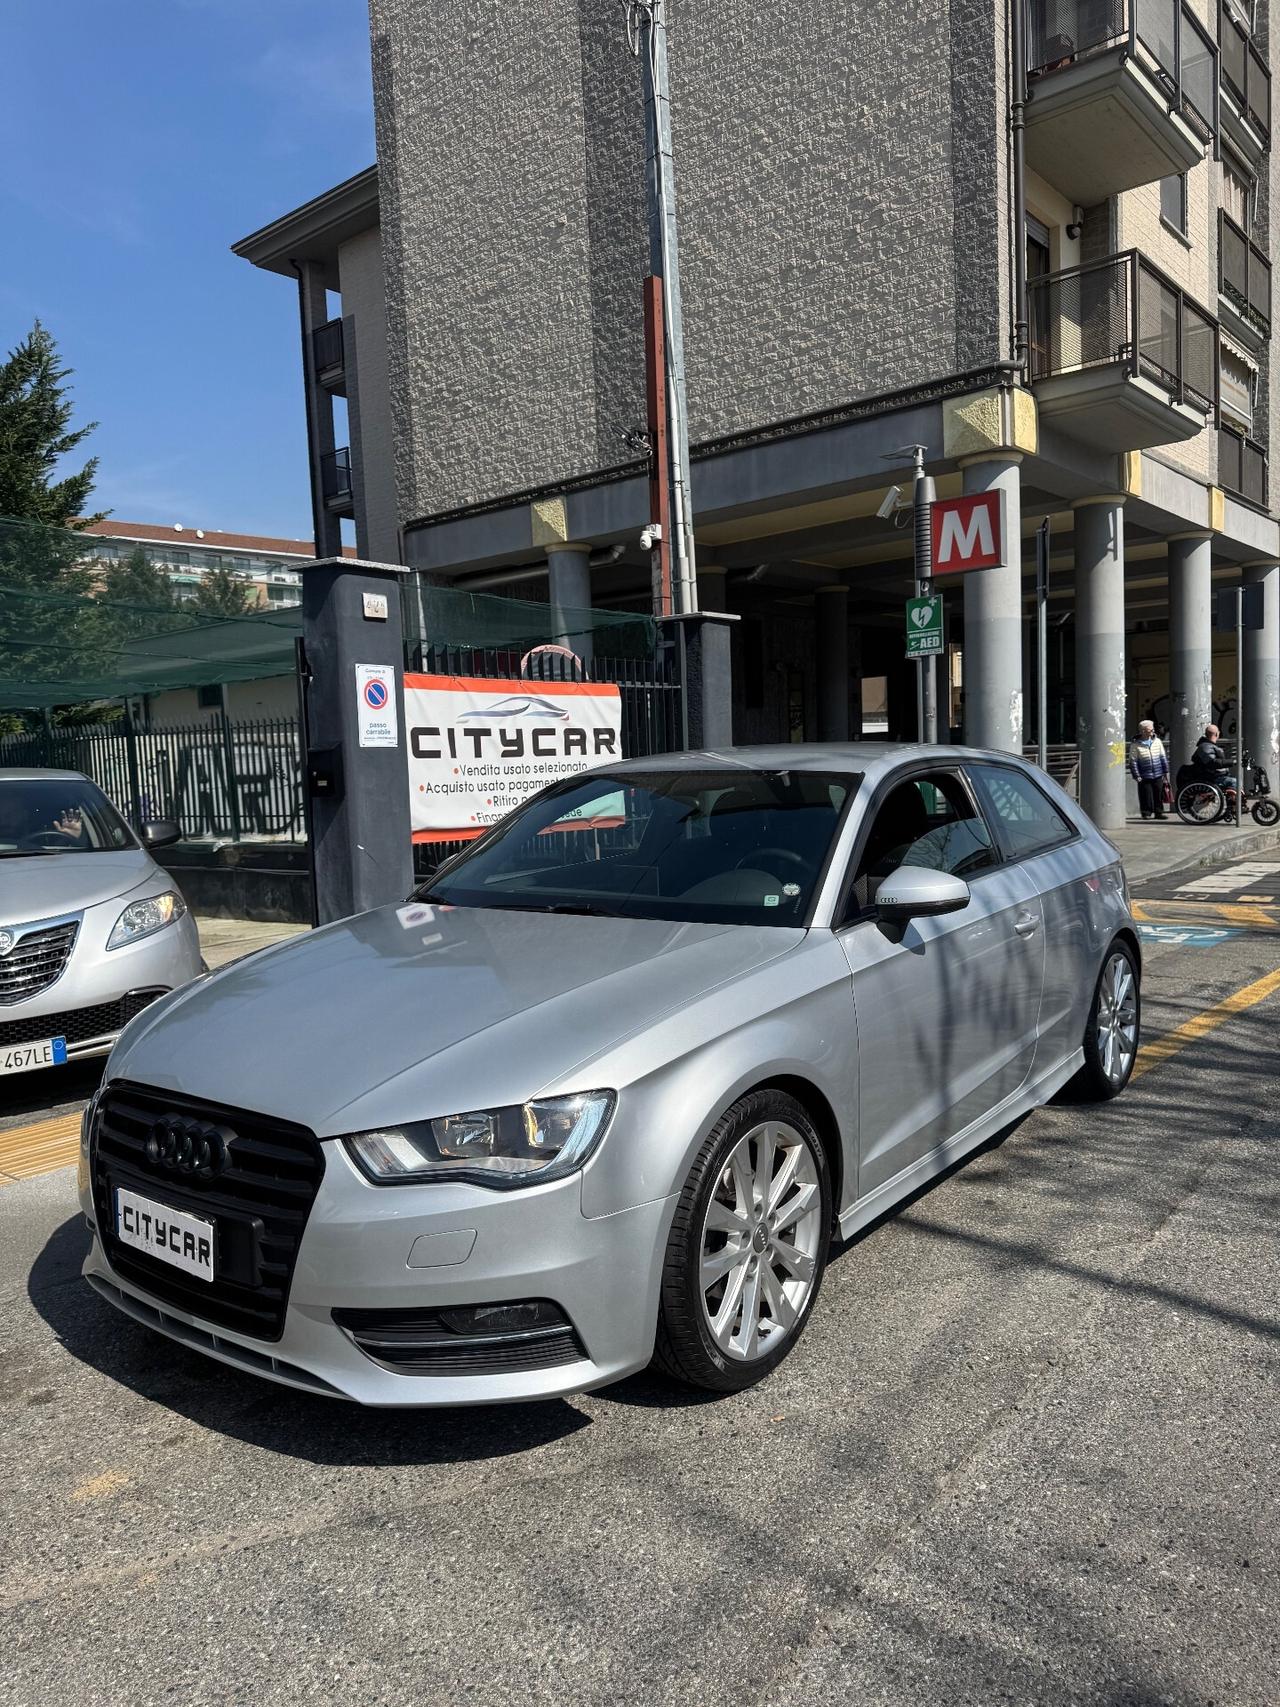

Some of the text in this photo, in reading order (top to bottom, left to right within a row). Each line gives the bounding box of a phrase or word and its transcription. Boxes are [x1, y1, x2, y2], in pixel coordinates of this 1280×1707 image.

[938, 504, 995, 563] M
[920, 636, 940, 649] AED
[410, 727, 616, 758] CITYCAR
[460, 761, 588, 776] Vendita usato selezionato
[426, 777, 560, 796] Acquisto usato pagament
[493, 795, 519, 807] Ritiro
[123, 1205, 210, 1268] CITYCAR
